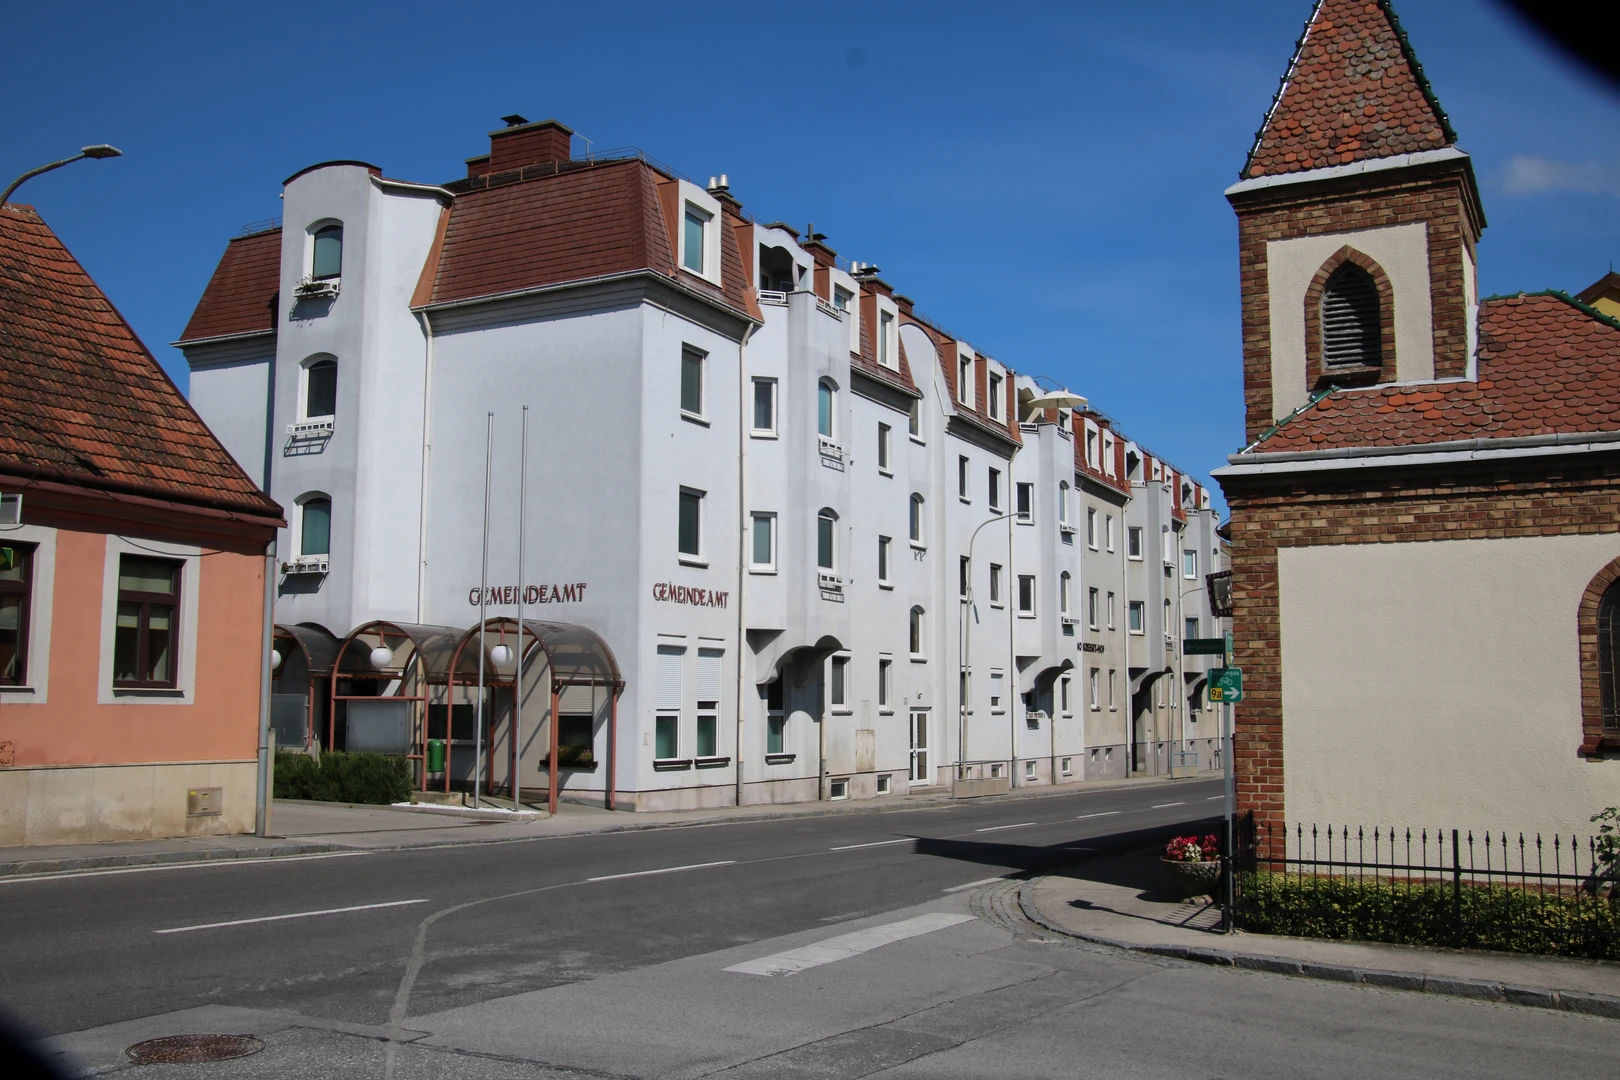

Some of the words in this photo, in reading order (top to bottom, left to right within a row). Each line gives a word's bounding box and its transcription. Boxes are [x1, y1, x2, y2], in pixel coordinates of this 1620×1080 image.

[469, 583, 587, 606] GEMEINDEAMT
[653, 582, 729, 609] GEMEINDEAMT
[1212, 689, 1222, 698] 9a
